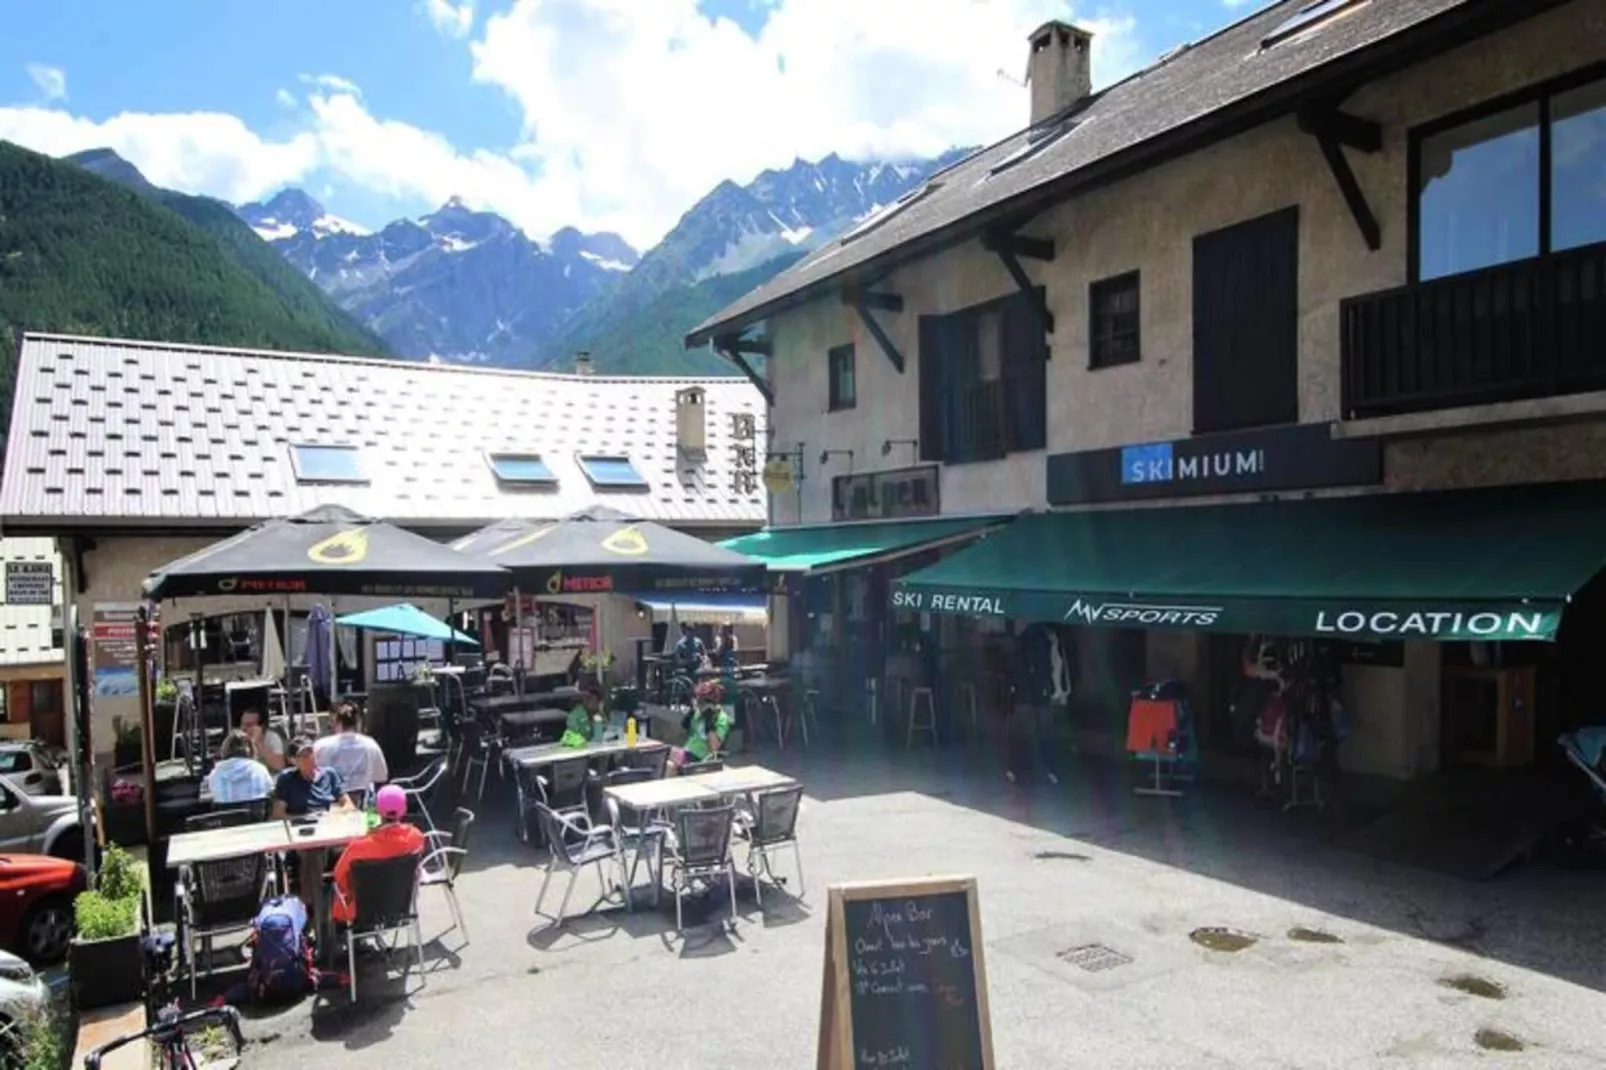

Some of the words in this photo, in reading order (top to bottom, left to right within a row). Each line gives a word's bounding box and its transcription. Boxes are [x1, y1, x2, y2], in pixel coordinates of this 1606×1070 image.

[892, 591, 923, 607] SKI
[931, 594, 1005, 615] RENTAL
[1315, 610, 1543, 634] LOCATION
